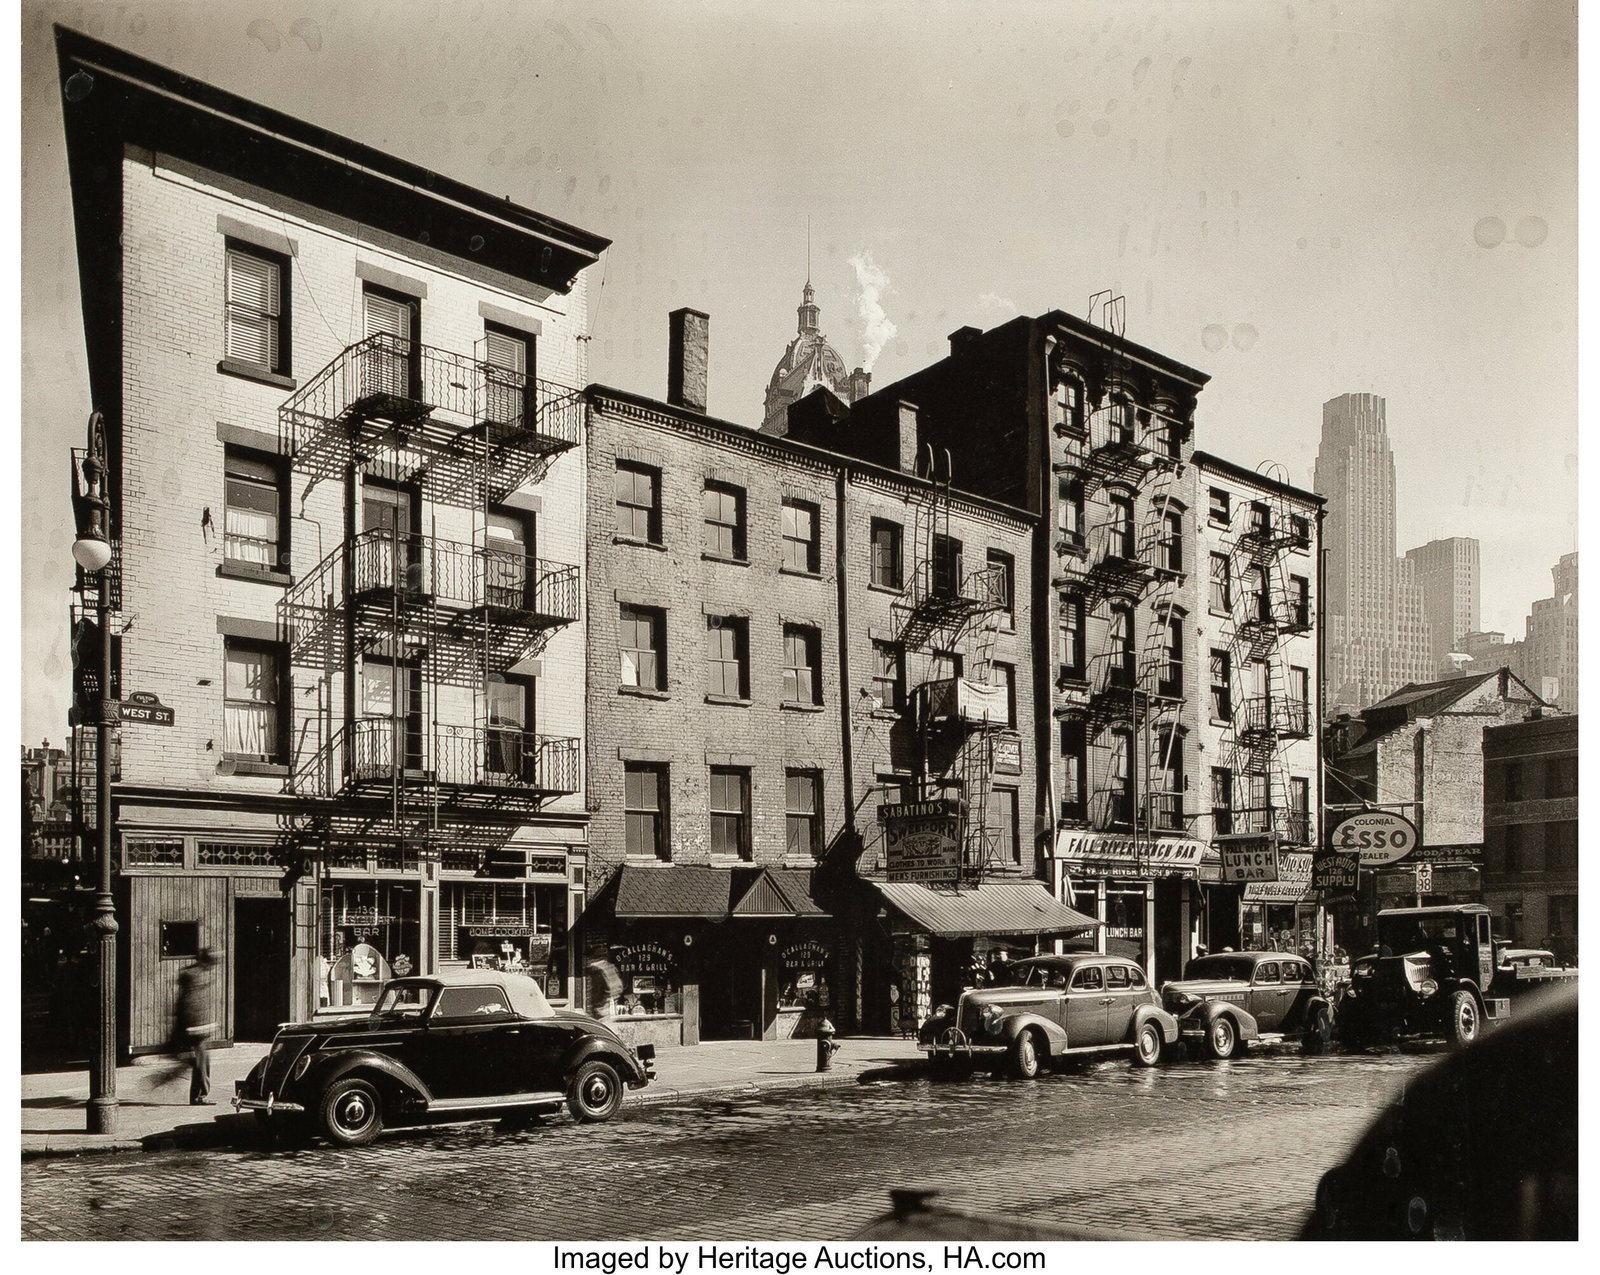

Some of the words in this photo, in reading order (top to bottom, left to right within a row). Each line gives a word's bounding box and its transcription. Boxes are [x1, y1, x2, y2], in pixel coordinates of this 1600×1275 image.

[122, 707, 151, 719] WEST
[155, 712, 170, 721] ST.
[883, 802, 943, 818] SABATINO'S
[1340, 825, 1407, 849] ESSO
[1068, 838, 1095, 853] FALL
[1102, 840, 1134, 855] RIVER
[1139, 841, 1170, 857] LUNCH
[1175, 845, 1197, 859] BAR
[1246, 844, 1270, 853] RIVER
[1225, 853, 1273, 867] LUNCH
[1359, 852, 1390, 860] DEALER
[927, 859, 945, 867] WORK
[1315, 856, 1335, 872] WEST
[1335, 856, 1356, 872] AUTO
[889, 872, 909, 881] MEN'S
[911, 870, 957, 880] FURNISHINGS
[1112, 867, 1137, 876] RIVER
[1236, 868, 1265, 879] BAR
[1316, 875, 1355, 886] SUPPLY
[353, 927, 380, 936] BAR
[469, 927, 494, 936] HOME
[495, 927, 534, 937] COOKING
[1073, 928, 1094, 938] VER
[1106, 927, 1128, 938] LUNCH
[1129, 927, 1143, 938] BAR
[638, 954, 651, 962] 129
[620, 964, 636, 972] BAR
[645, 963, 668, 971] GRILL
